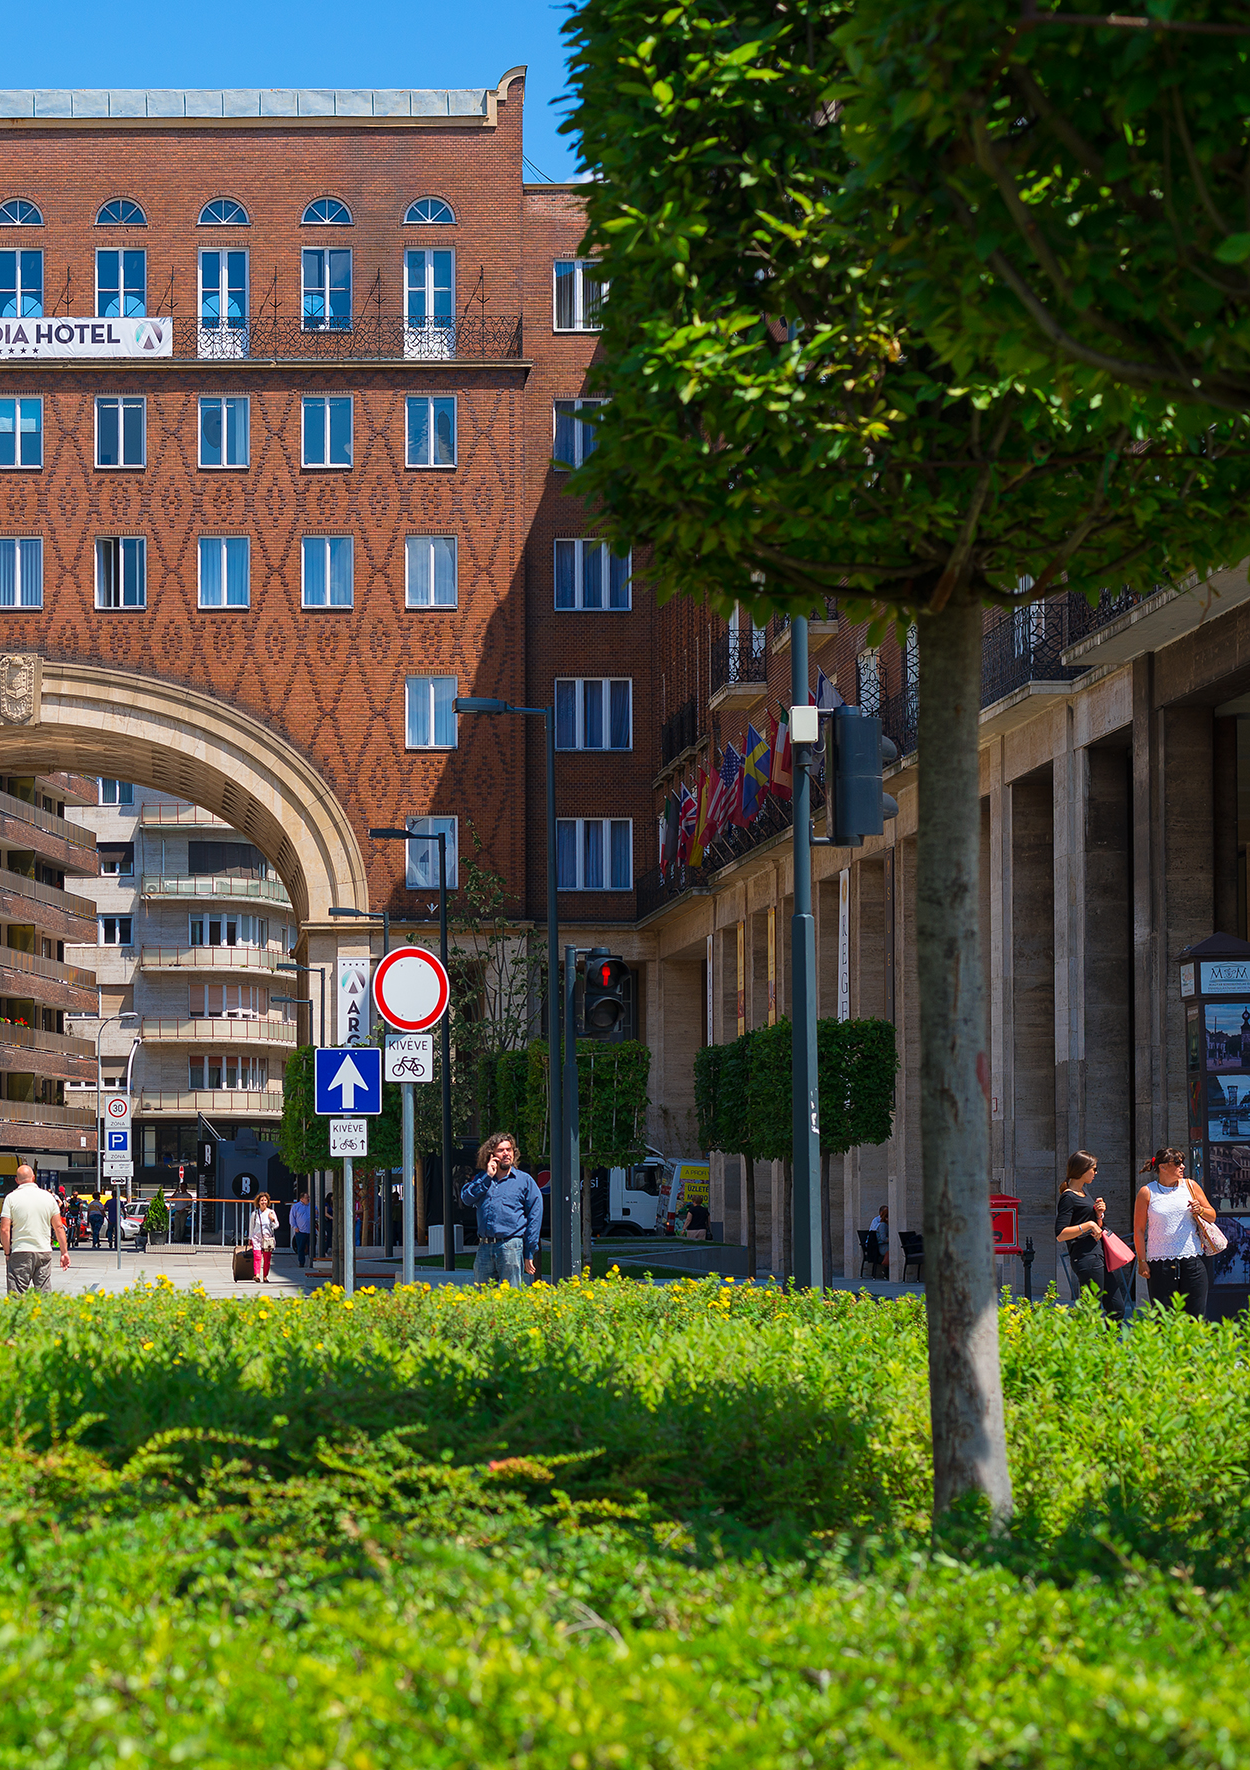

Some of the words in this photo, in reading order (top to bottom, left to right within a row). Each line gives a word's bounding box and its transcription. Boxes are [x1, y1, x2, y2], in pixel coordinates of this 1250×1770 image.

[36, 323, 121, 344] HOTEL
[388, 1038, 428, 1051] KIVÉVE
[112, 1104, 123, 1113] 30
[332, 1124, 364, 1133] KIVÉVE
[112, 1134, 124, 1148] P
